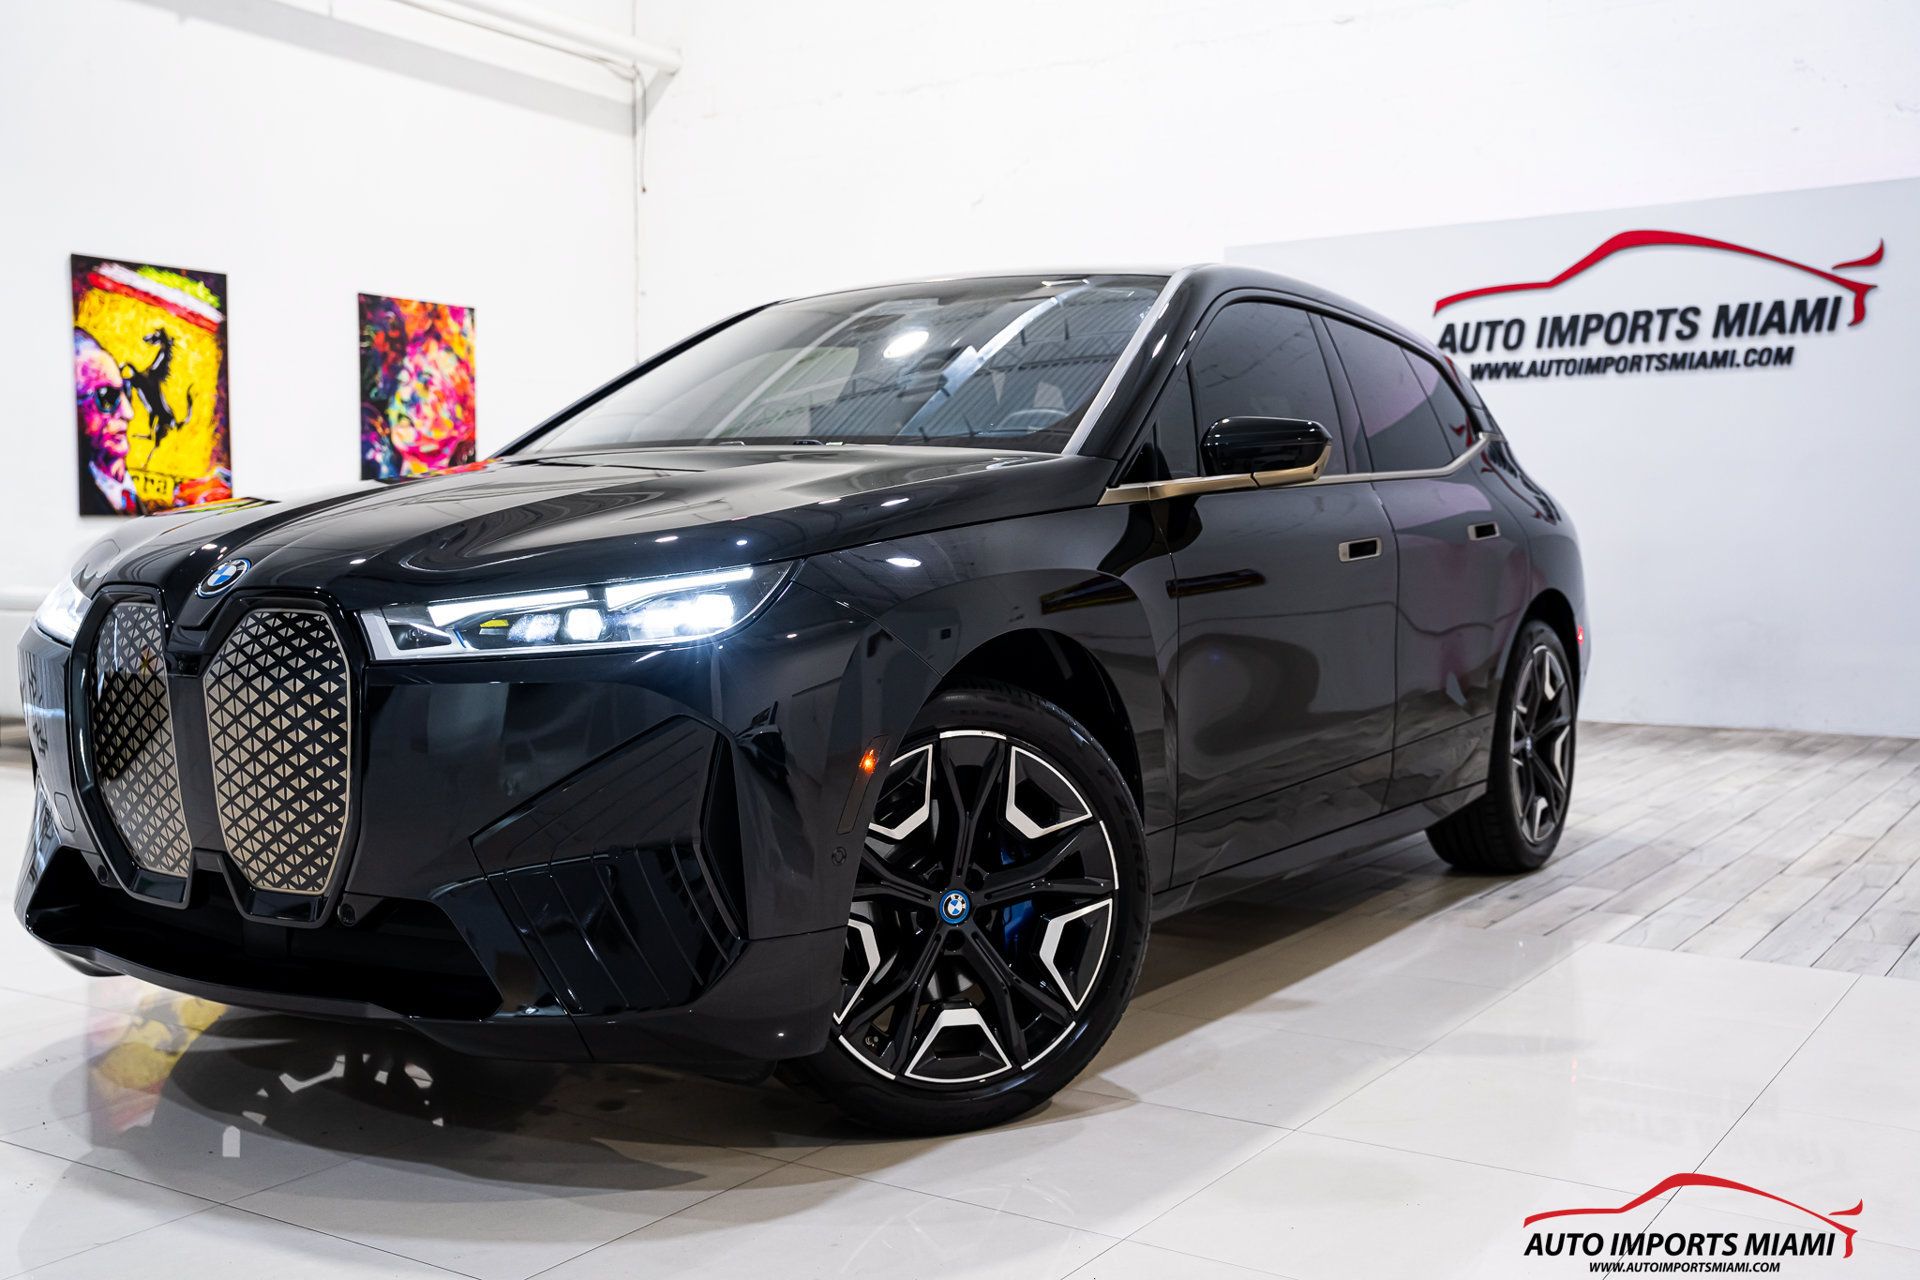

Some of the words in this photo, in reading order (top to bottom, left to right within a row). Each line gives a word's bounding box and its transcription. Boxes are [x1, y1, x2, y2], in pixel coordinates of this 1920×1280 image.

[1438, 318, 1525, 354] AUTO
[1536, 306, 1701, 349] IMPORTS
[1712, 296, 1842, 339] MIAMI
[1470, 346, 1795, 380] WWW.AUTOIMPORTSMIAMI.COM
